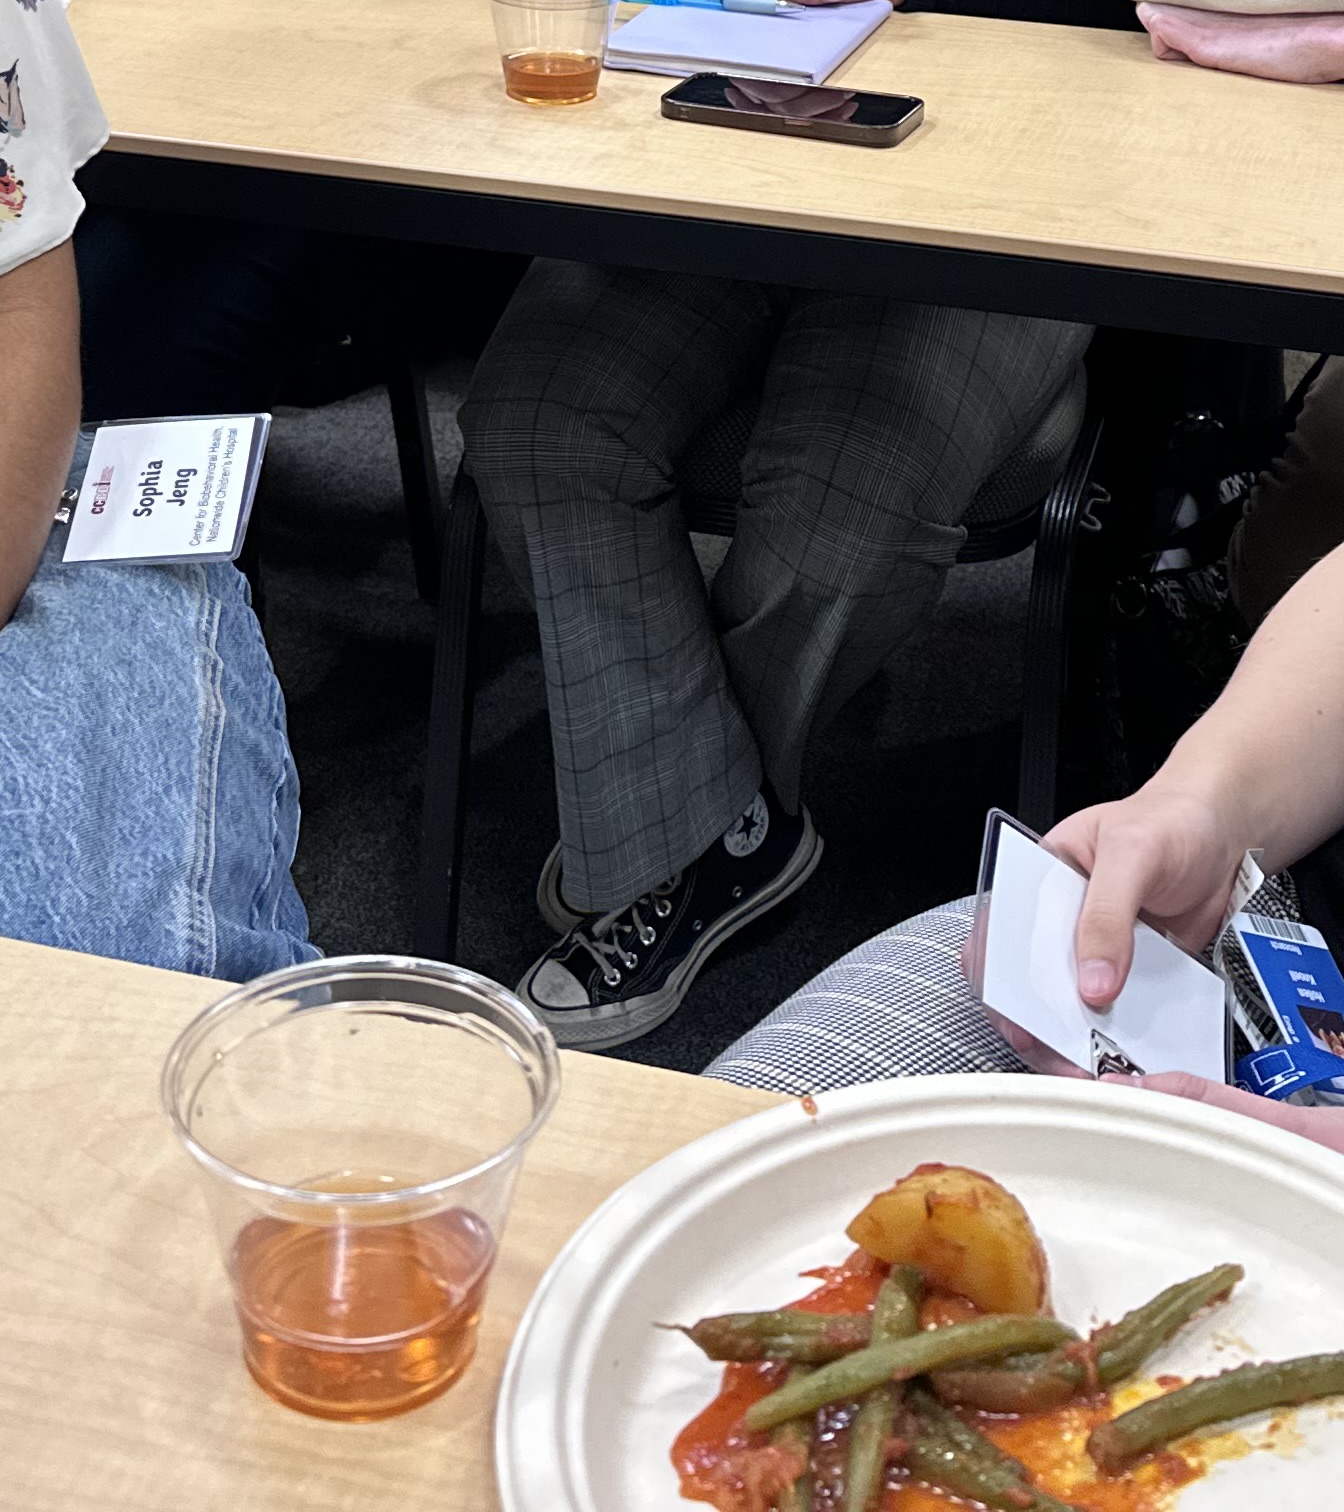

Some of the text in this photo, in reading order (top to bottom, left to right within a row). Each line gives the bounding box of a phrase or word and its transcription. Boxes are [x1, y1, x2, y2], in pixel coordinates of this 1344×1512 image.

[132, 459, 163, 517] Sophia
[166, 468, 198, 507] Jeng
[198, 454, 219, 507] Biobehavioral
[206, 427, 238, 543] Nationwide Children's Hospital
[189, 520, 205, 547] Center
[195, 509, 207, 520] for
